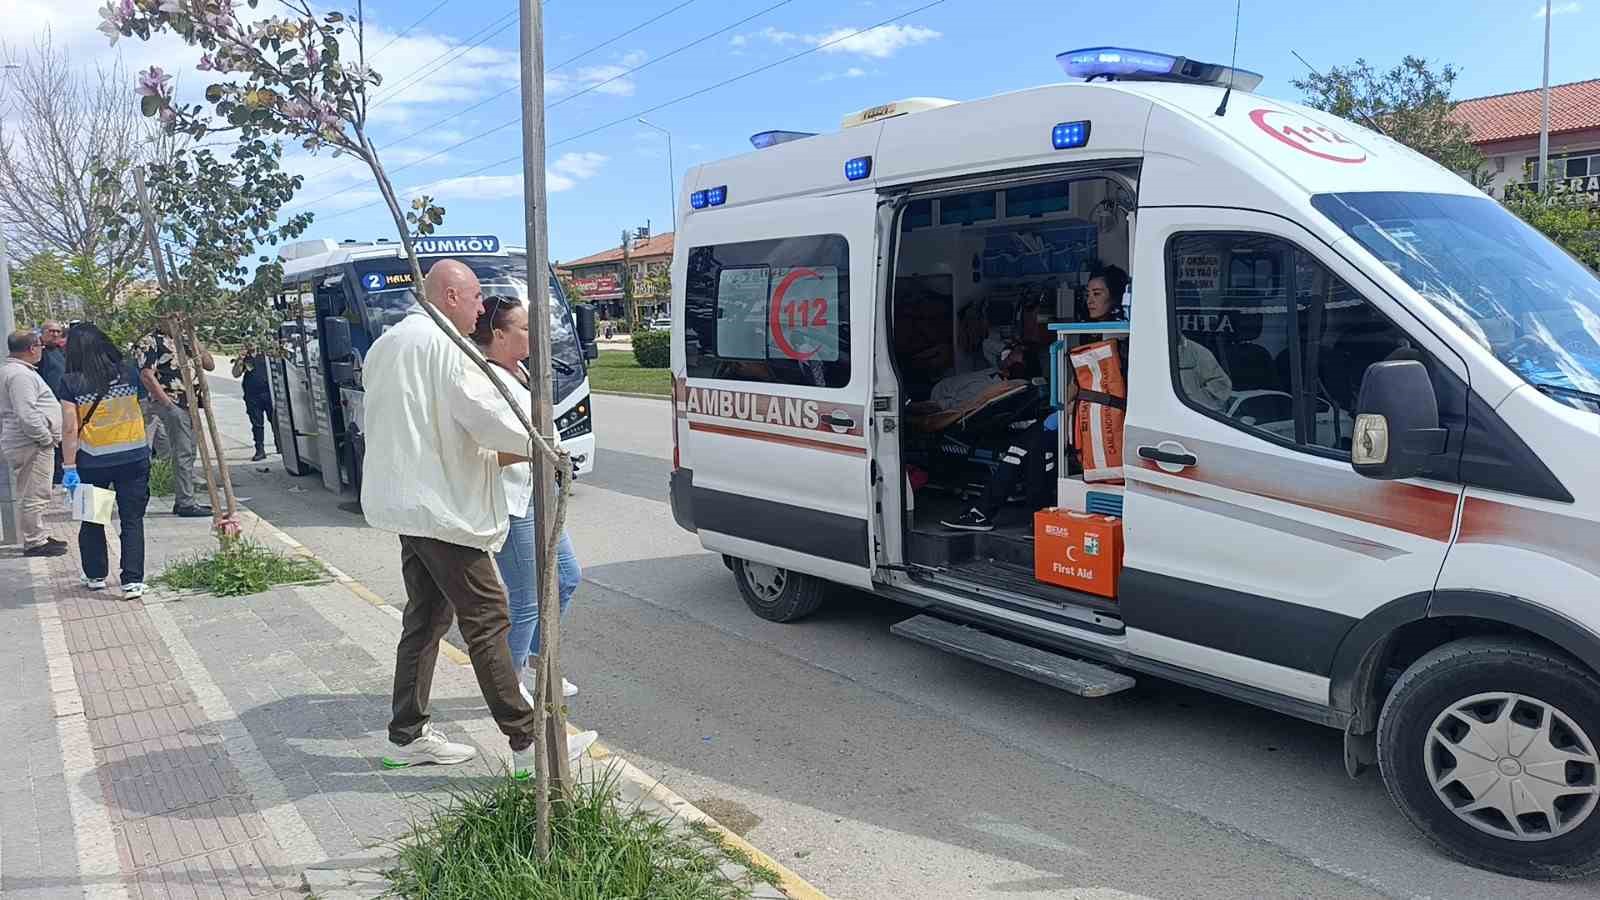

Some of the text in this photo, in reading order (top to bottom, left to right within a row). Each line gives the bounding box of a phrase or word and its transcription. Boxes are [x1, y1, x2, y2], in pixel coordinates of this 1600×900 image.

[369, 273, 412, 288] 2 HALK
[784, 298, 828, 328] 112
[687, 387, 819, 430] AMBULANS
[1053, 562, 1093, 579] First Aid
